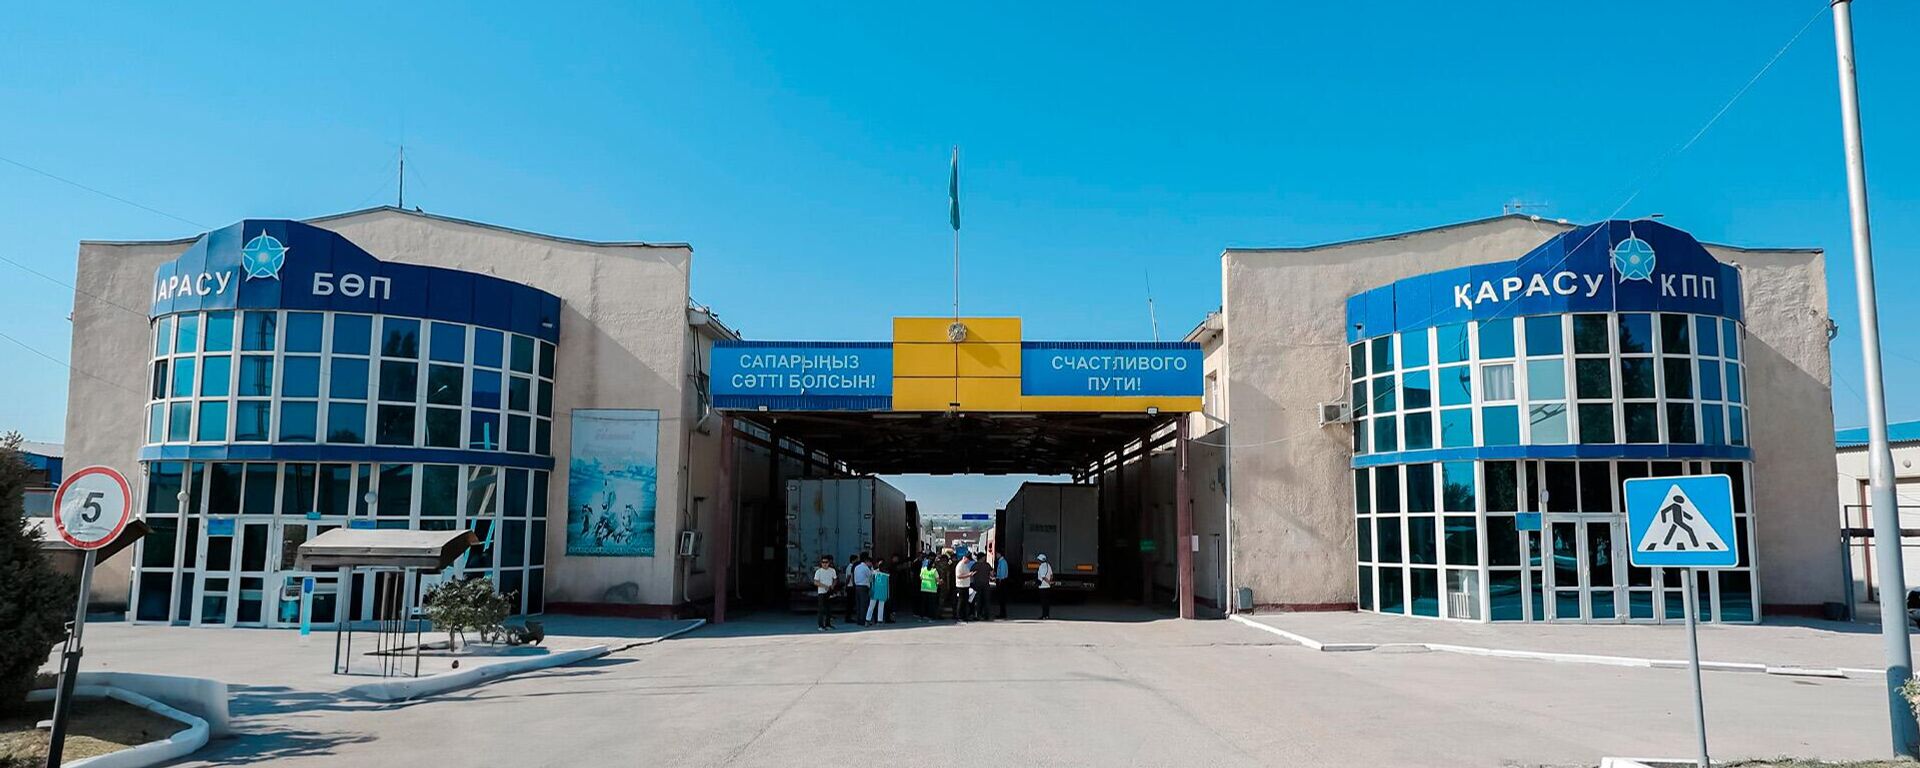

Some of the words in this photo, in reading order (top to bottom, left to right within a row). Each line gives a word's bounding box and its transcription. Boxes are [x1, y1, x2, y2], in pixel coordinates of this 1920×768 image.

[153, 271, 232, 302] АРАСУ
[312, 272, 391, 300] БӨП
[1454, 271, 1604, 310] ҚАРАСУ
[1661, 273, 1716, 300] КПП
[739, 354, 860, 371] САПАРЫҢЫЗ
[1051, 356, 1188, 371] СЧАСТЛИВОГО
[731, 374, 783, 389] СӘТТІ
[789, 374, 876, 389] БОЛСЫН!
[1088, 377, 1142, 391] ПУТИ!
[81, 491, 104, 523] 5
